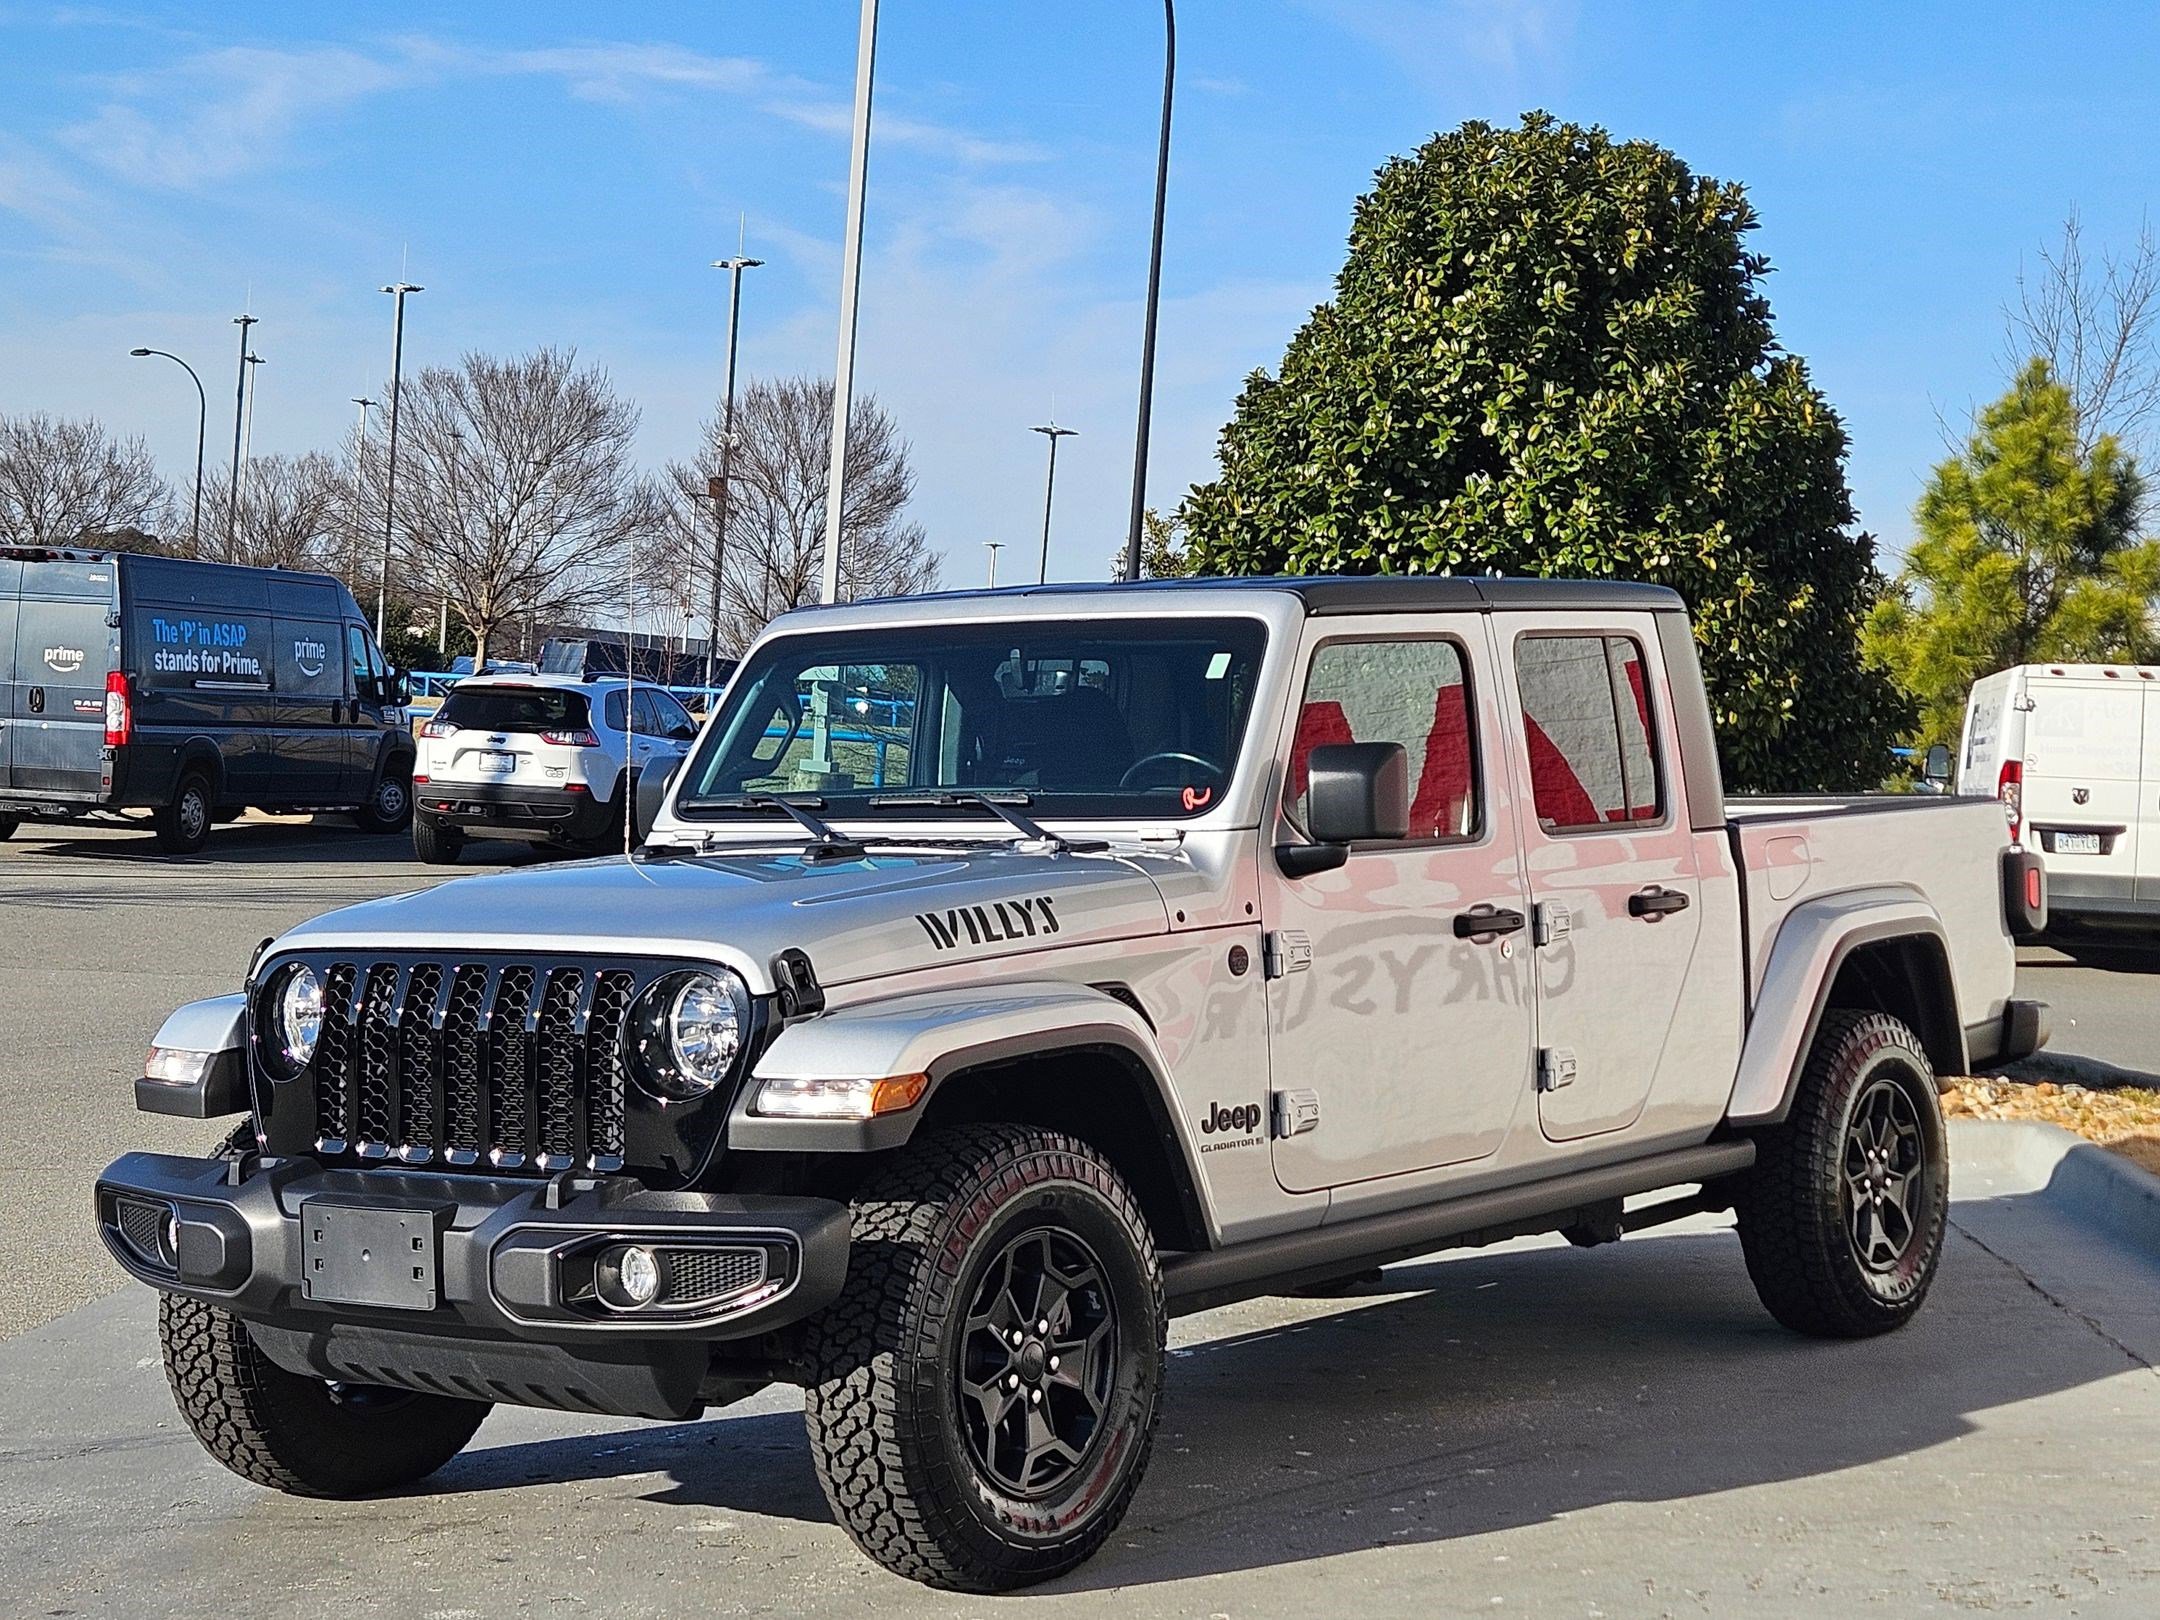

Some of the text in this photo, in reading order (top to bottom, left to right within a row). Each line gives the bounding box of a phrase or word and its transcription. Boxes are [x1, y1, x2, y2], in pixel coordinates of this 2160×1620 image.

[153, 619, 178, 643] The
[198, 622, 210, 645] in
[213, 623, 246, 647] ASAP
[44, 645, 84, 662] prime
[155, 648, 262, 676] stands for Prime.
[294, 637, 325, 662] prime
[915, 895, 1060, 950] WILLYS
[1201, 1101, 1261, 1134] Jeep
[1201, 1138, 1254, 1153] GLADIATOR
